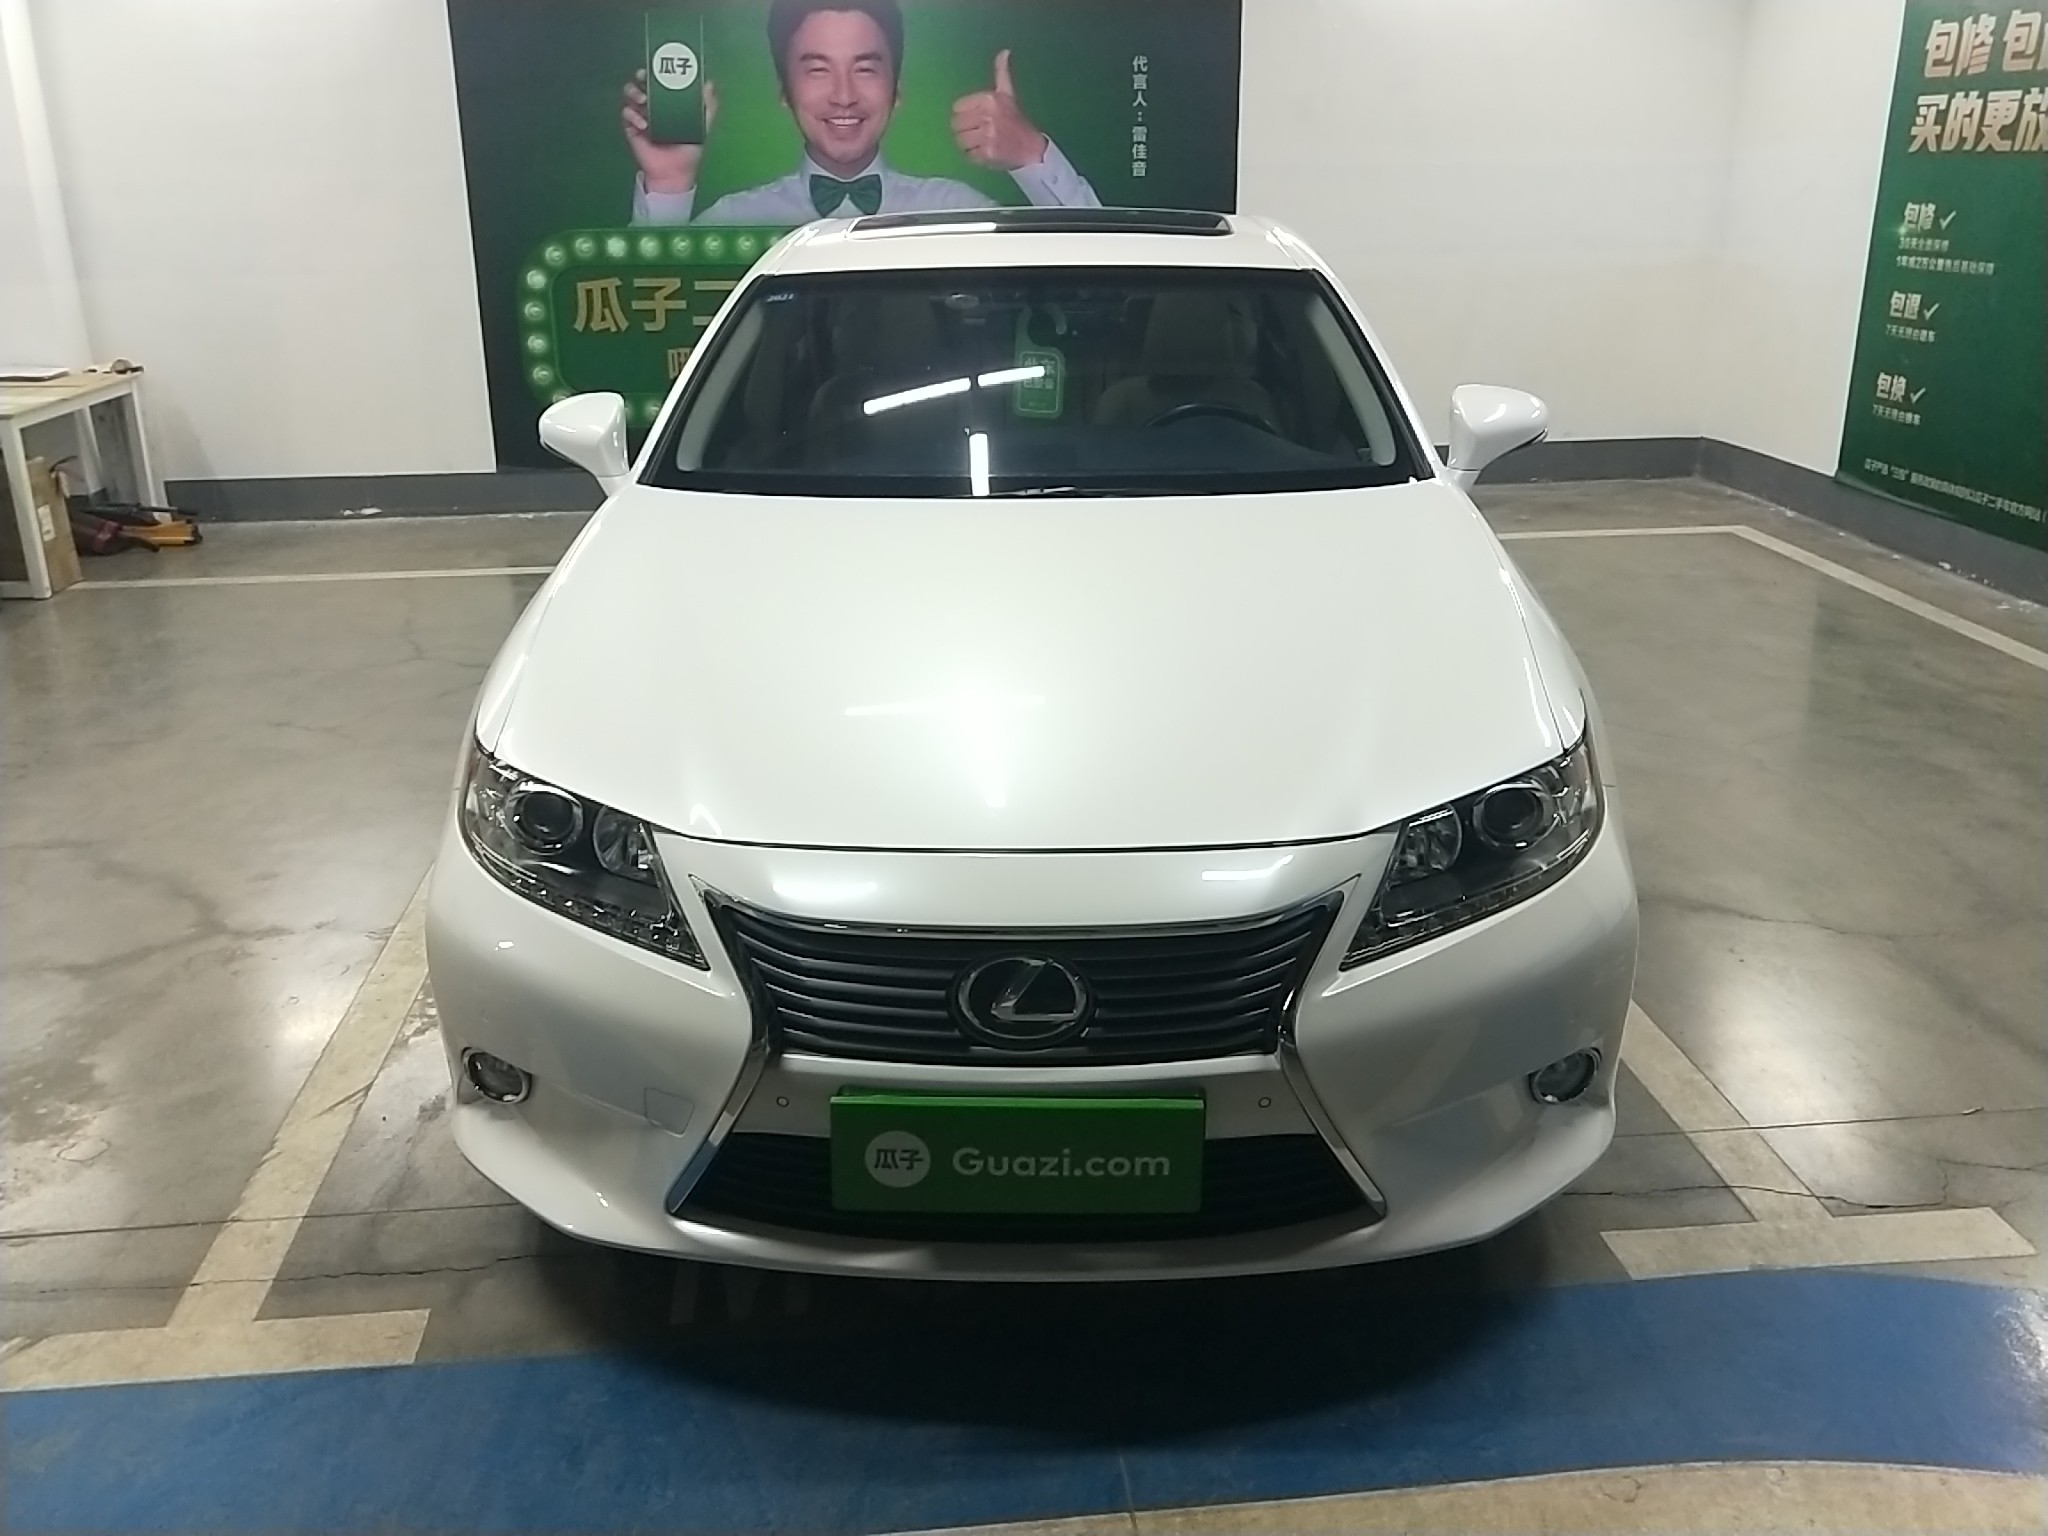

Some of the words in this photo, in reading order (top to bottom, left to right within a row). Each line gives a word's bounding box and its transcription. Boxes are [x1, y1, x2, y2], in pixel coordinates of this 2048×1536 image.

[1924, 14, 1997, 77] 包修
[2003, 9, 2048, 71] 包
[659, 57, 693, 75] 瓜子
[873, 1148, 924, 1171] 瓜子
[952, 1147, 1171, 1177] Guazi.com
